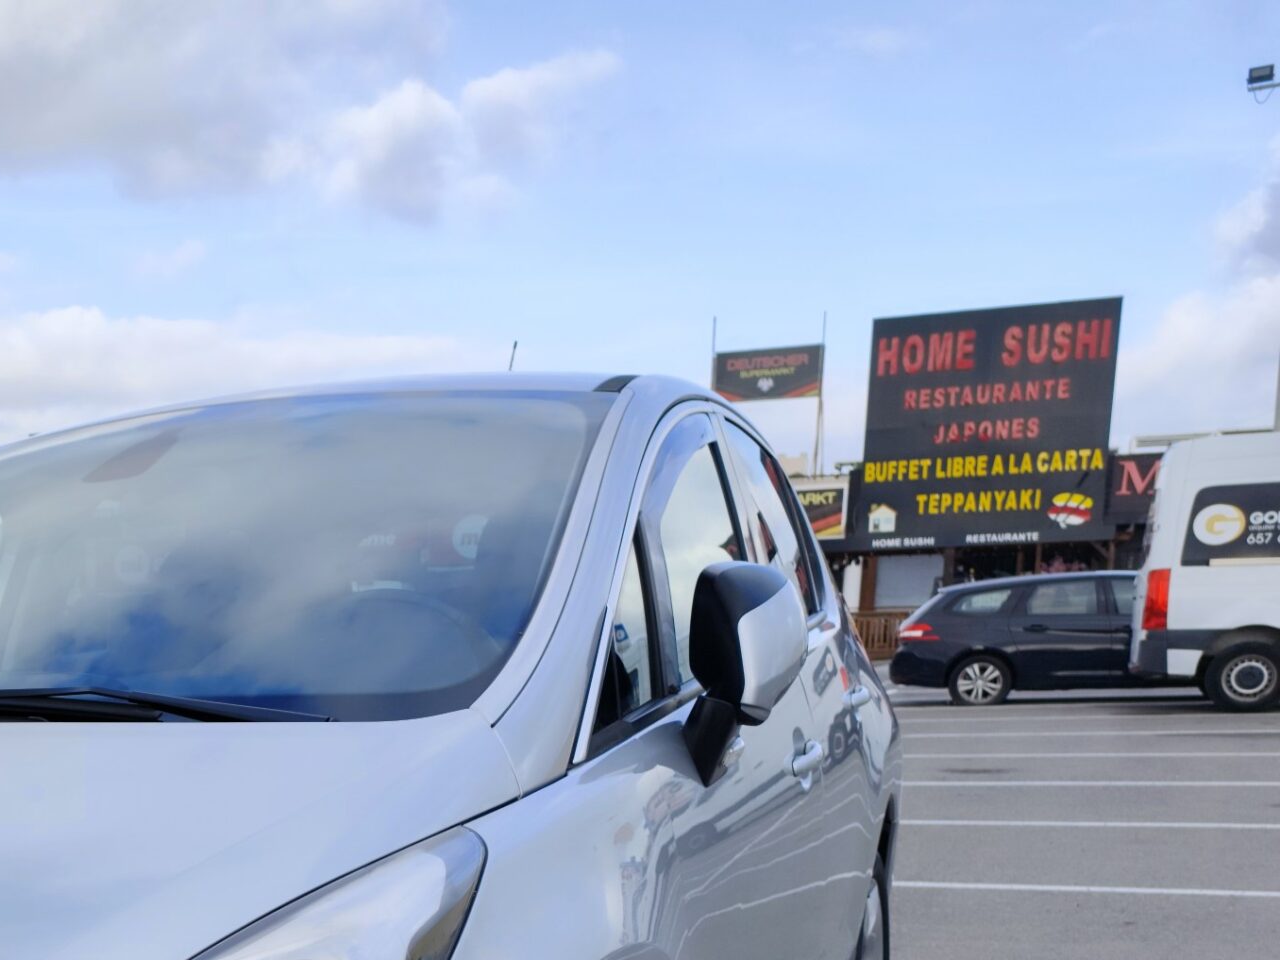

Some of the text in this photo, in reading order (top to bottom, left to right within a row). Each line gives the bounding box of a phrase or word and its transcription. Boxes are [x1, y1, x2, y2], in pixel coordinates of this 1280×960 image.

[876, 318, 1113, 377] HOME SUSHI
[725, 353, 809, 371] DEUTSCHER
[904, 377, 1071, 410] RESTAURANTE
[933, 417, 1040, 444] JAPONES
[864, 448, 1104, 483] BUFFET LIBRE A LA CARTA
[916, 489, 1042, 515] TEPPANYAKI
[871, 536, 935, 549] HOME SUSHI
[965, 531, 1039, 544] RESTAURANTE
[1246, 532, 1273, 545] 657
